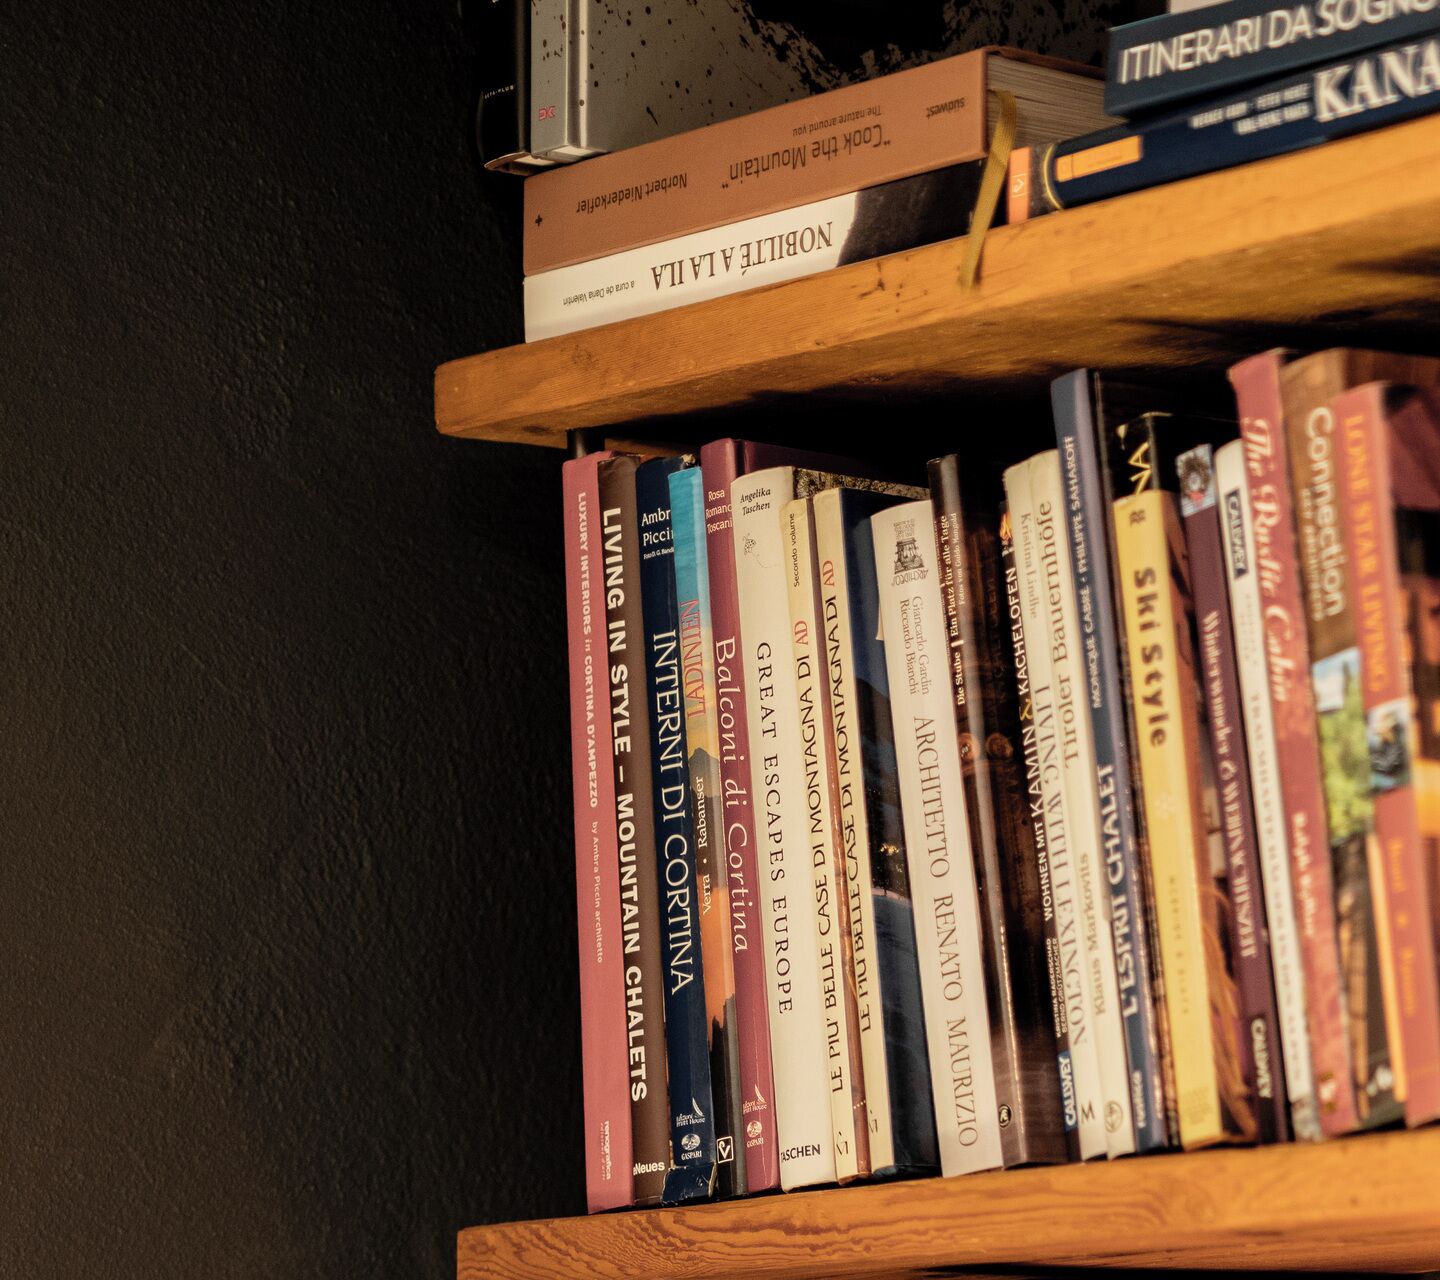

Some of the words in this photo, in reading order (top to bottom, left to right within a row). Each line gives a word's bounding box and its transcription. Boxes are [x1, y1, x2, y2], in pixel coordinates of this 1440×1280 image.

[1119, 20, 1261, 84] ITINERARI
[1268, 10, 1313, 49] DA
[792, 120, 807, 137] you
[810, 115, 837, 130] around
[839, 109, 865, 125] nature
[867, 105, 881, 117] The
[926, 98, 965, 119] südwest
[576, 182, 642, 215] Niederkofler
[646, 172, 687, 197] Norbert
[650, 259, 684, 290] ILA
[689, 252, 715, 281] LA
[720, 245, 735, 273] A
[739, 221, 832, 276] NOBILTÉ
[788, 513, 797, 547] volume
[1306, 407, 1347, 617] Connection
[603, 508, 625, 610] LIVING
[791, 548, 800, 587] Secondo
[1036, 501, 1068, 663] Bauernhöfe
[608, 620, 628, 652] IN
[794, 621, 809, 646] AD
[1134, 567, 1160, 630] Ski
[678, 600, 706, 718] LADINIEN
[757, 642, 777, 738] GREAT
[797, 655, 810, 677] DI
[1140, 644, 1169, 747] Style
[611, 665, 631, 755] STYLE
[652, 629, 682, 773] INTERNI
[714, 637, 745, 764] Balconi
[1034, 685, 1062, 784] LIVING
[1055, 674, 1080, 768] Tiroler
[723, 779, 747, 808] di
[800, 687, 823, 834] MONTAGNA
[912, 716, 950, 879] ARCHITETTO
[661, 786, 685, 823] DI
[763, 754, 786, 882] ESCAPES
[1045, 792, 1068, 869] WITH
[1097, 764, 1126, 885] CHALET
[616, 794, 640, 954] MOUNTAIN
[726, 823, 752, 954] Cortina
[811, 842, 826, 866] DI
[662, 834, 694, 995] CORTINA
[814, 874, 831, 936] CASE
[771, 896, 792, 1015] EUROPE
[820, 947, 837, 1007] BELLE
[932, 895, 963, 1001] RENATO
[1056, 880, 1086, 1046] LEXINGTON
[1110, 891, 1139, 1018] L'ESPRIT
[624, 966, 647, 1101] CHALETS
[831, 1066, 844, 1092] LE
[945, 1017, 979, 1148] MAURIZIO
